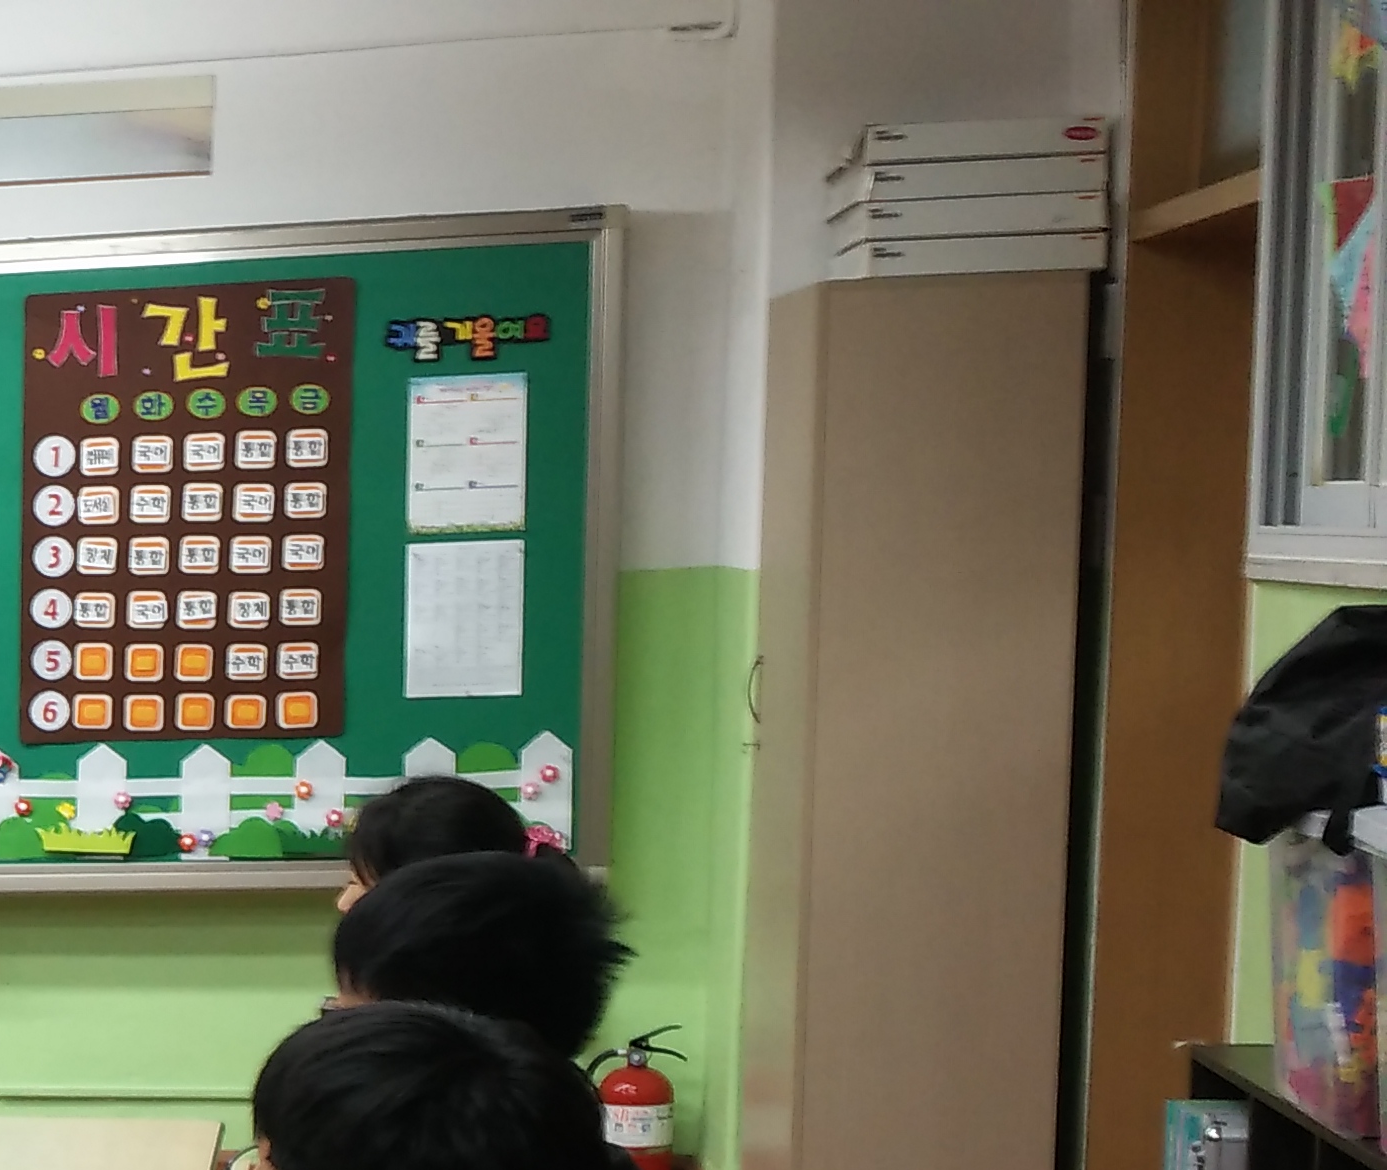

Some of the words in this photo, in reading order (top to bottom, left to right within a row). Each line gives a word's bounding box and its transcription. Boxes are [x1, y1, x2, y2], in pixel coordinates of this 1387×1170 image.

[46, 288, 327, 383] 시간표
[442, 315, 549, 359] 기울여요
[91, 397, 110, 420] 월
[141, 392, 167, 416] 화
[196, 391, 218, 415] 수
[247, 390, 269, 414] 목
[300, 388, 319, 411] 금
[50, 446, 61, 468] 1
[137, 444, 168, 462] 국어
[189, 443, 221, 460] 국어
[47, 493, 63, 516] 2
[136, 496, 167, 512] 수학
[241, 493, 272, 511] 국어
[47, 545, 61, 569] 3
[236, 546, 266, 564] 국어
[288, 543, 320, 561] 국어
[43, 598, 59, 621] 4
[135, 602, 165, 620] 국어
[45, 650, 60, 672] 5
[231, 655, 262, 671] 수학
[284, 653, 315, 670] 수학
[42, 701, 58, 723] 6
